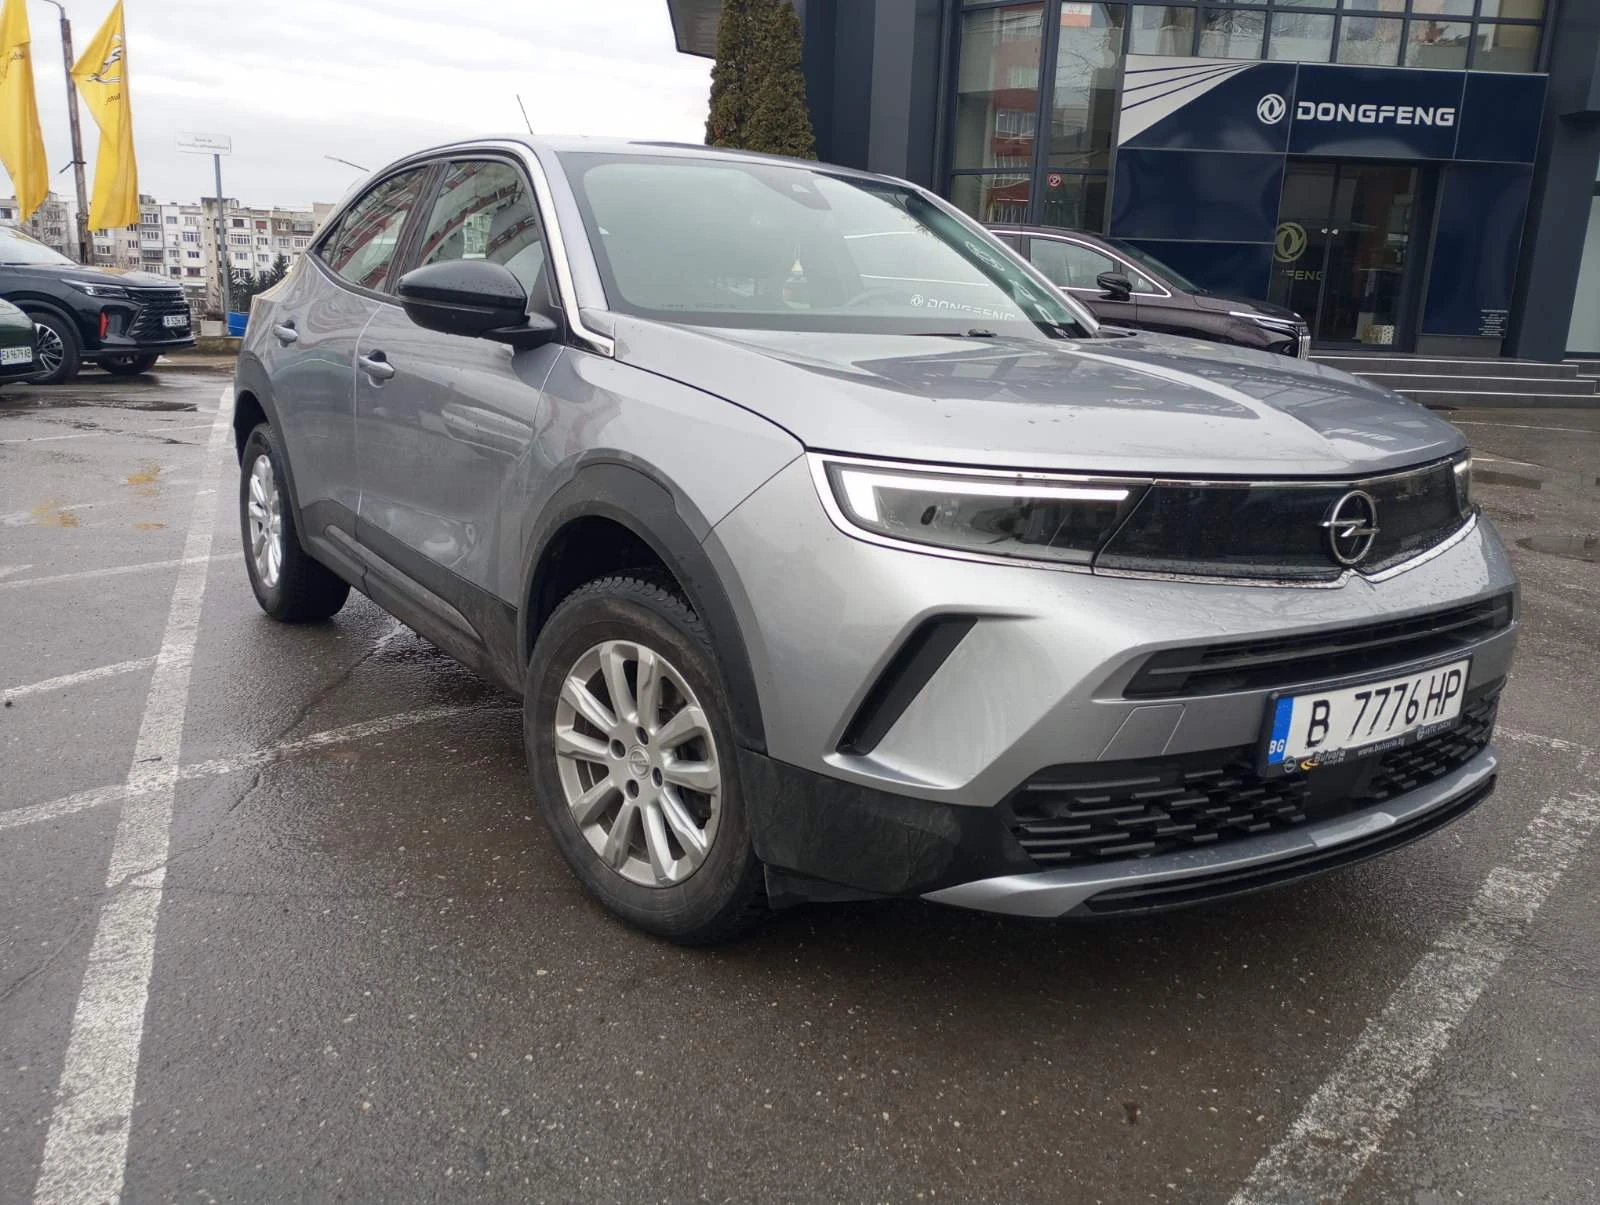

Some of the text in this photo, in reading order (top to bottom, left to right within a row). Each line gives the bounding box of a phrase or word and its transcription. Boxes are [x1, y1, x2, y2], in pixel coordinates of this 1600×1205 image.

[1297, 101, 1455, 126] DONGFENG
[1306, 699, 1331, 748] B
[1268, 739, 1285, 755] BG
